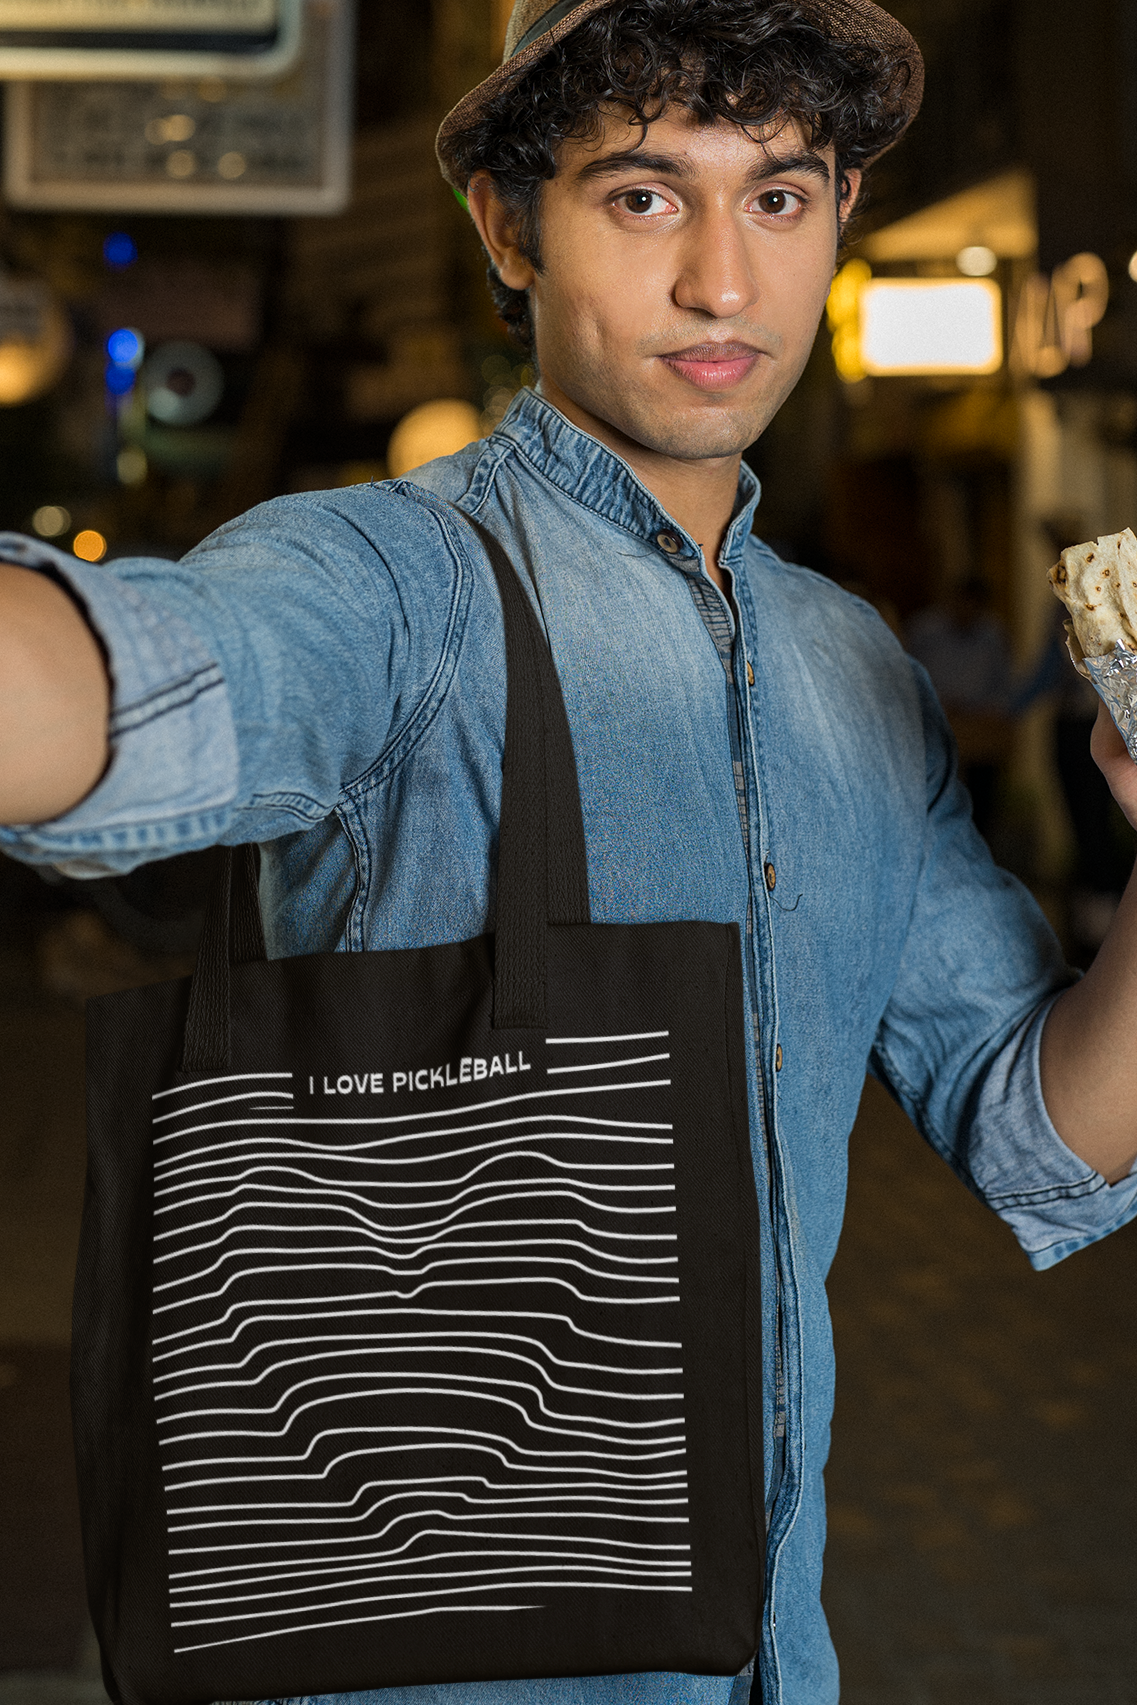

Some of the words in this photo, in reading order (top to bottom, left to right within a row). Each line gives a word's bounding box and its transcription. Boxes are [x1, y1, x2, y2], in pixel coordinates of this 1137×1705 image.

[309, 1075, 315, 1095] I
[323, 1073, 385, 1095] LOVE
[392, 1051, 532, 1093] PICKLEBALL
